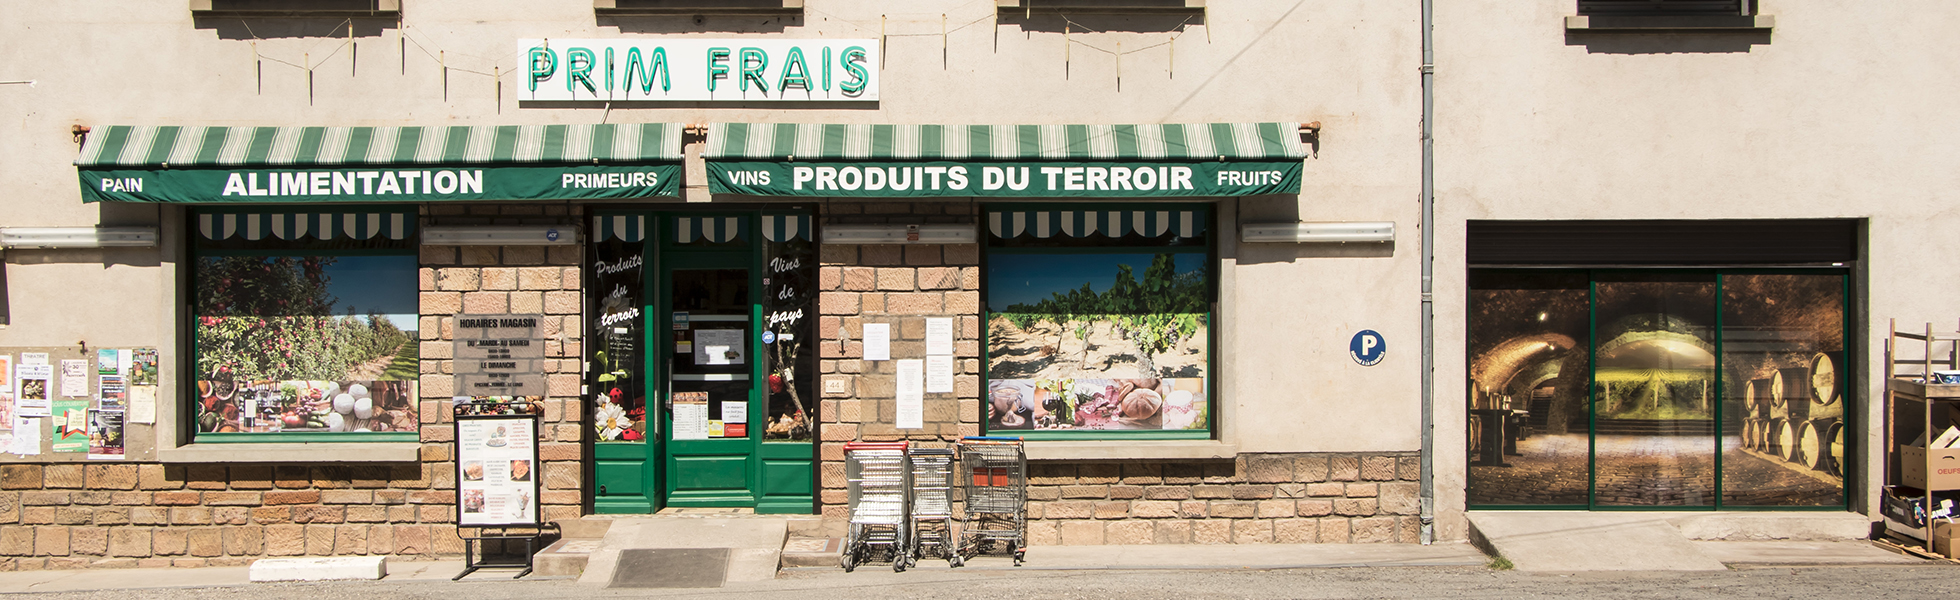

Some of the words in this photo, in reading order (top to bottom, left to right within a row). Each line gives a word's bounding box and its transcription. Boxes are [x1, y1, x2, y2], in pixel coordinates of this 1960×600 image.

[528, 46, 671, 94] PRIM
[706, 46, 870, 95] FRAIS
[101, 178, 143, 193] PAIN
[222, 170, 483, 196] ALIMENTATION
[562, 170, 658, 188] PRIMEURS
[727, 170, 771, 186] VINS
[793, 166, 969, 191] PRODUITS
[982, 166, 1030, 191] DU
[1041, 166, 1194, 191] TERROIR
[1217, 170, 1282, 186] FRUITS
[594, 254, 643, 278] Produits
[770, 257, 800, 273] Vins
[612, 283, 628, 298] du
[778, 284, 794, 300] de
[460, 318, 498, 328] HORAIRES
[500, 318, 537, 328] MAGASIN
[600, 307, 640, 327] terroir
[769, 308, 803, 328] pays
[1362, 334, 1378, 356] P
